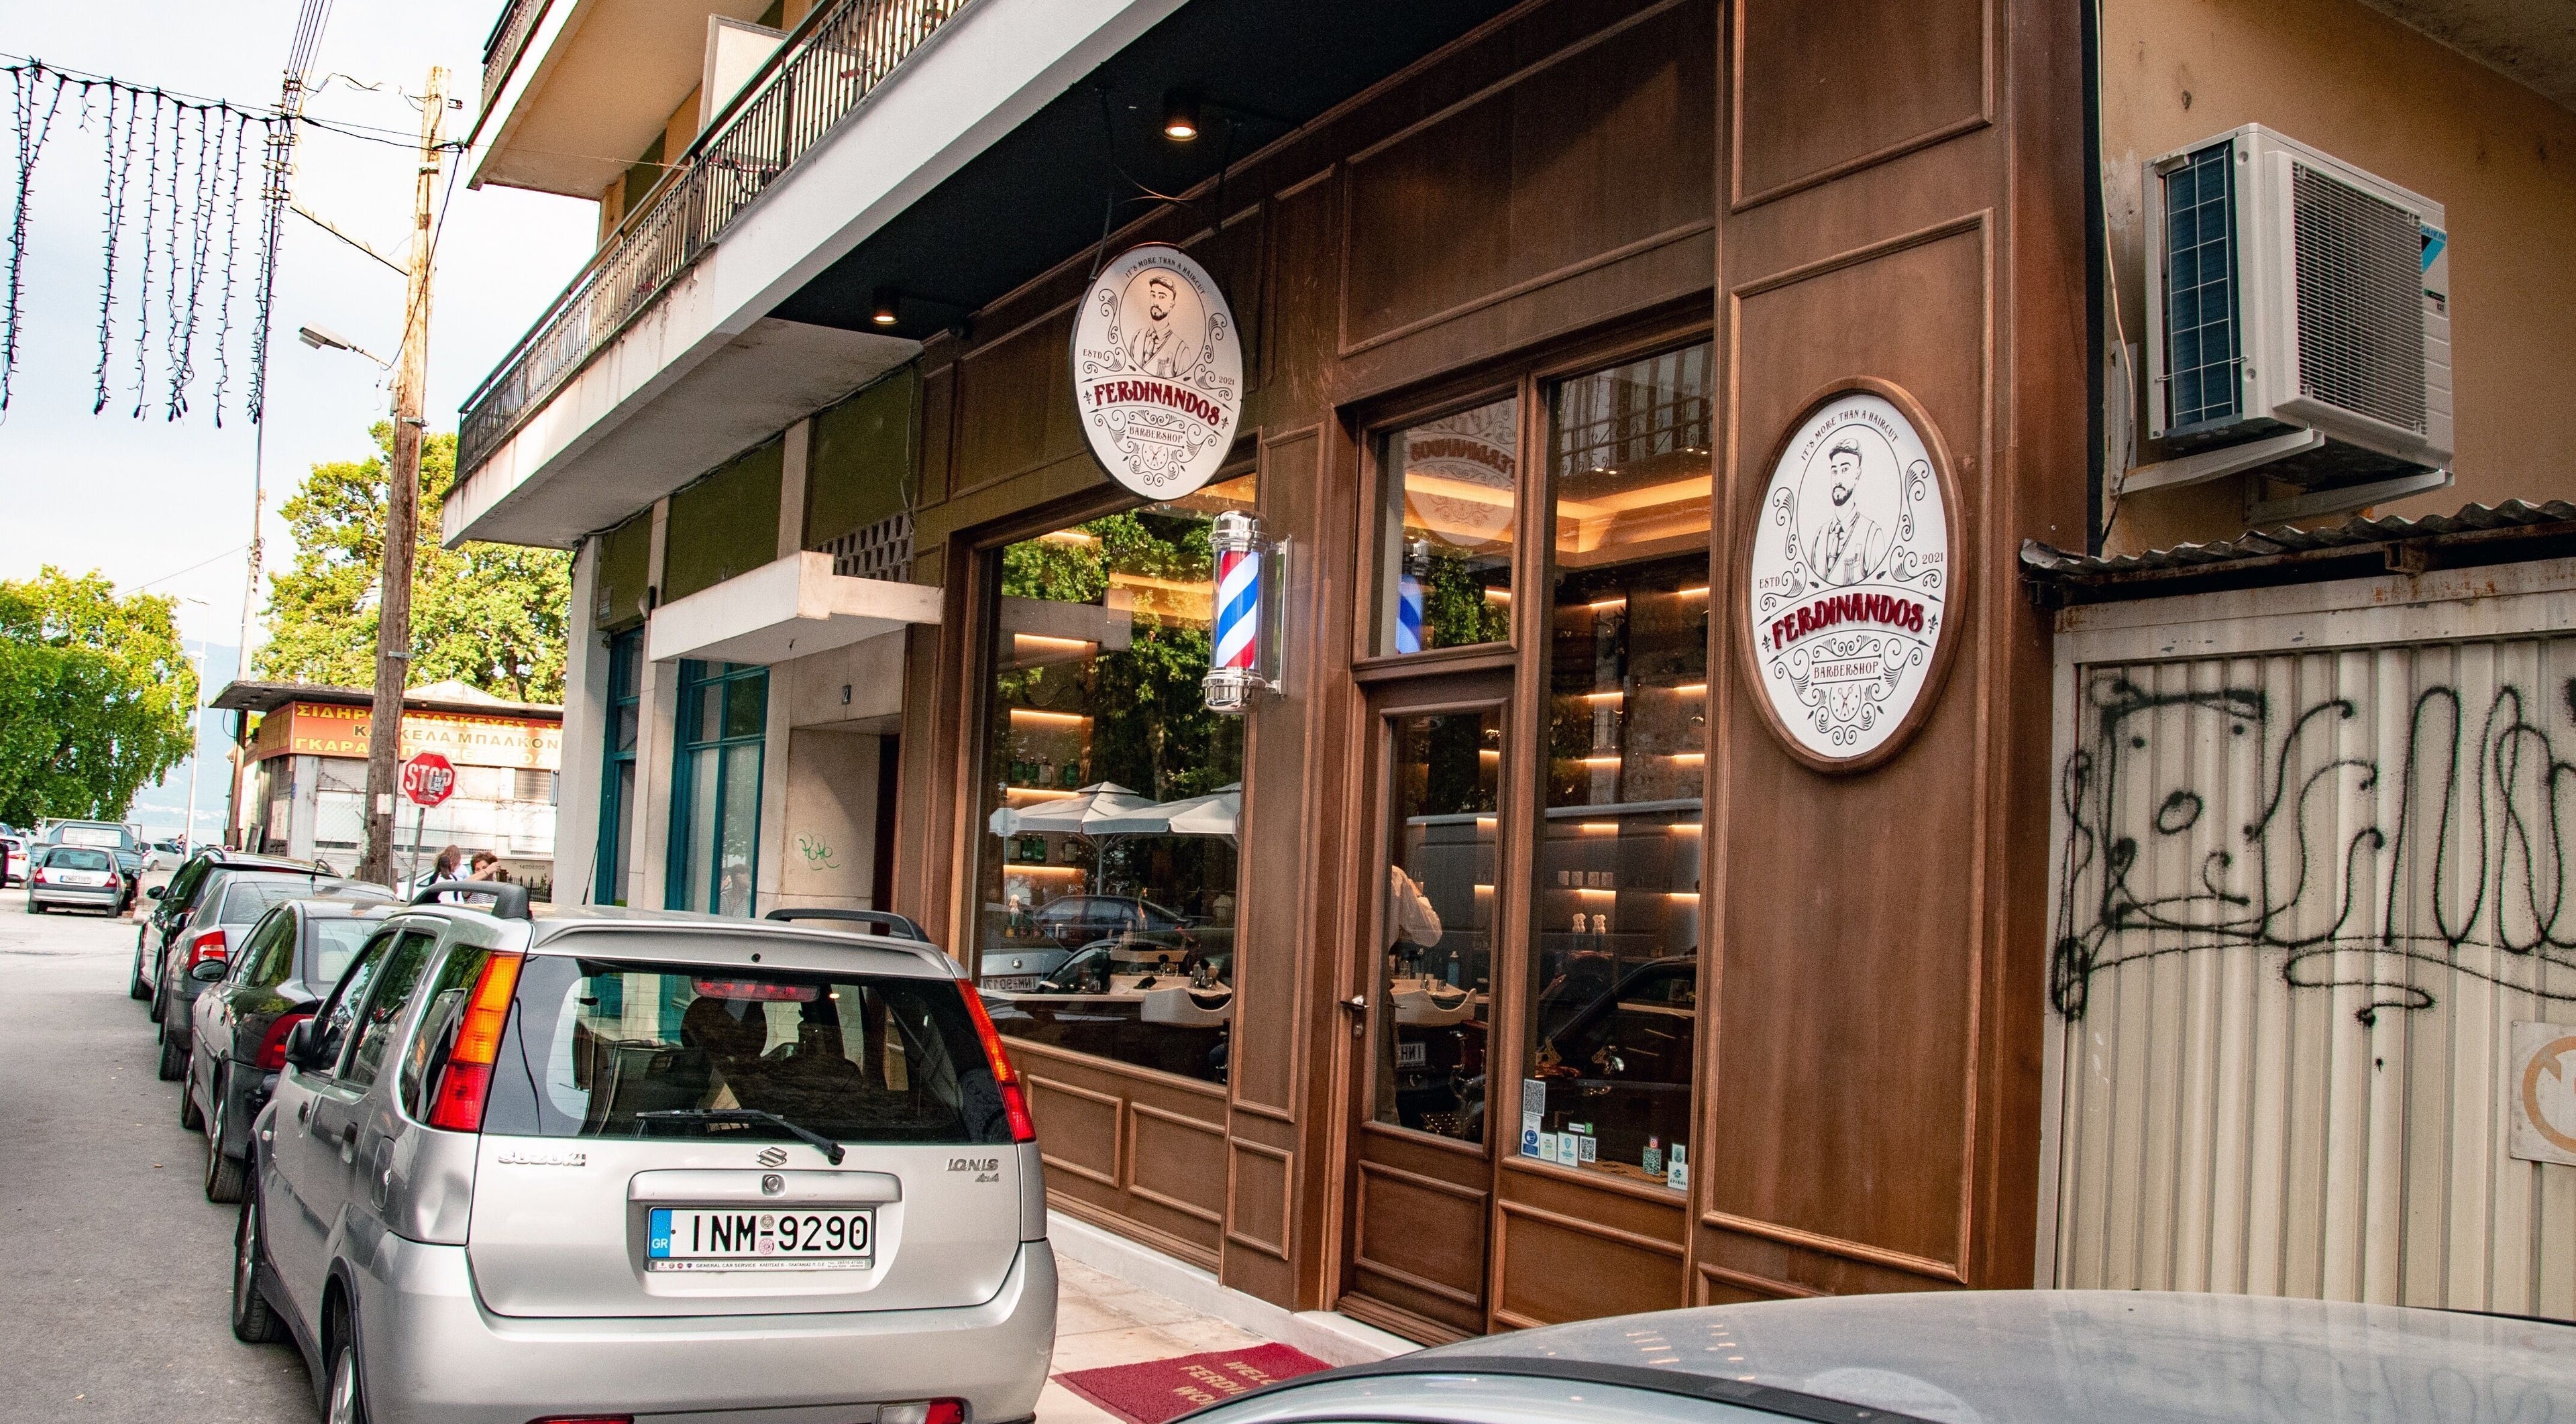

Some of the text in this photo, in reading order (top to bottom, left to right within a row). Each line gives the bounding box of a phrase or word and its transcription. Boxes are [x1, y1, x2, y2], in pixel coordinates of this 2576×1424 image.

[1138, 256, 1157, 270] MORE
[1159, 256, 1176, 266] THAN
[1183, 264, 1205, 294] HAIRCUT
[1083, 348, 1102, 359] ESTD
[1218, 376, 1235, 386] 2021
[1093, 380, 1220, 426] FERDINANDOS
[1129, 425, 1183, 443] BARBERSHOP
[1815, 417, 1837, 441] MORE
[1838, 408, 1860, 423] THAN
[1862, 409, 1868, 420] A
[1869, 410, 1900, 443] HAIRCUT
[1921, 551, 1944, 565] 2021
[1758, 576, 1780, 589] ESTD
[1772, 592, 1924, 650] FERDINANDOS
[1813, 661, 1880, 679] BARBERSHOP
[405, 763, 453, 795] STOP
[651, 1238, 668, 1249] GR
